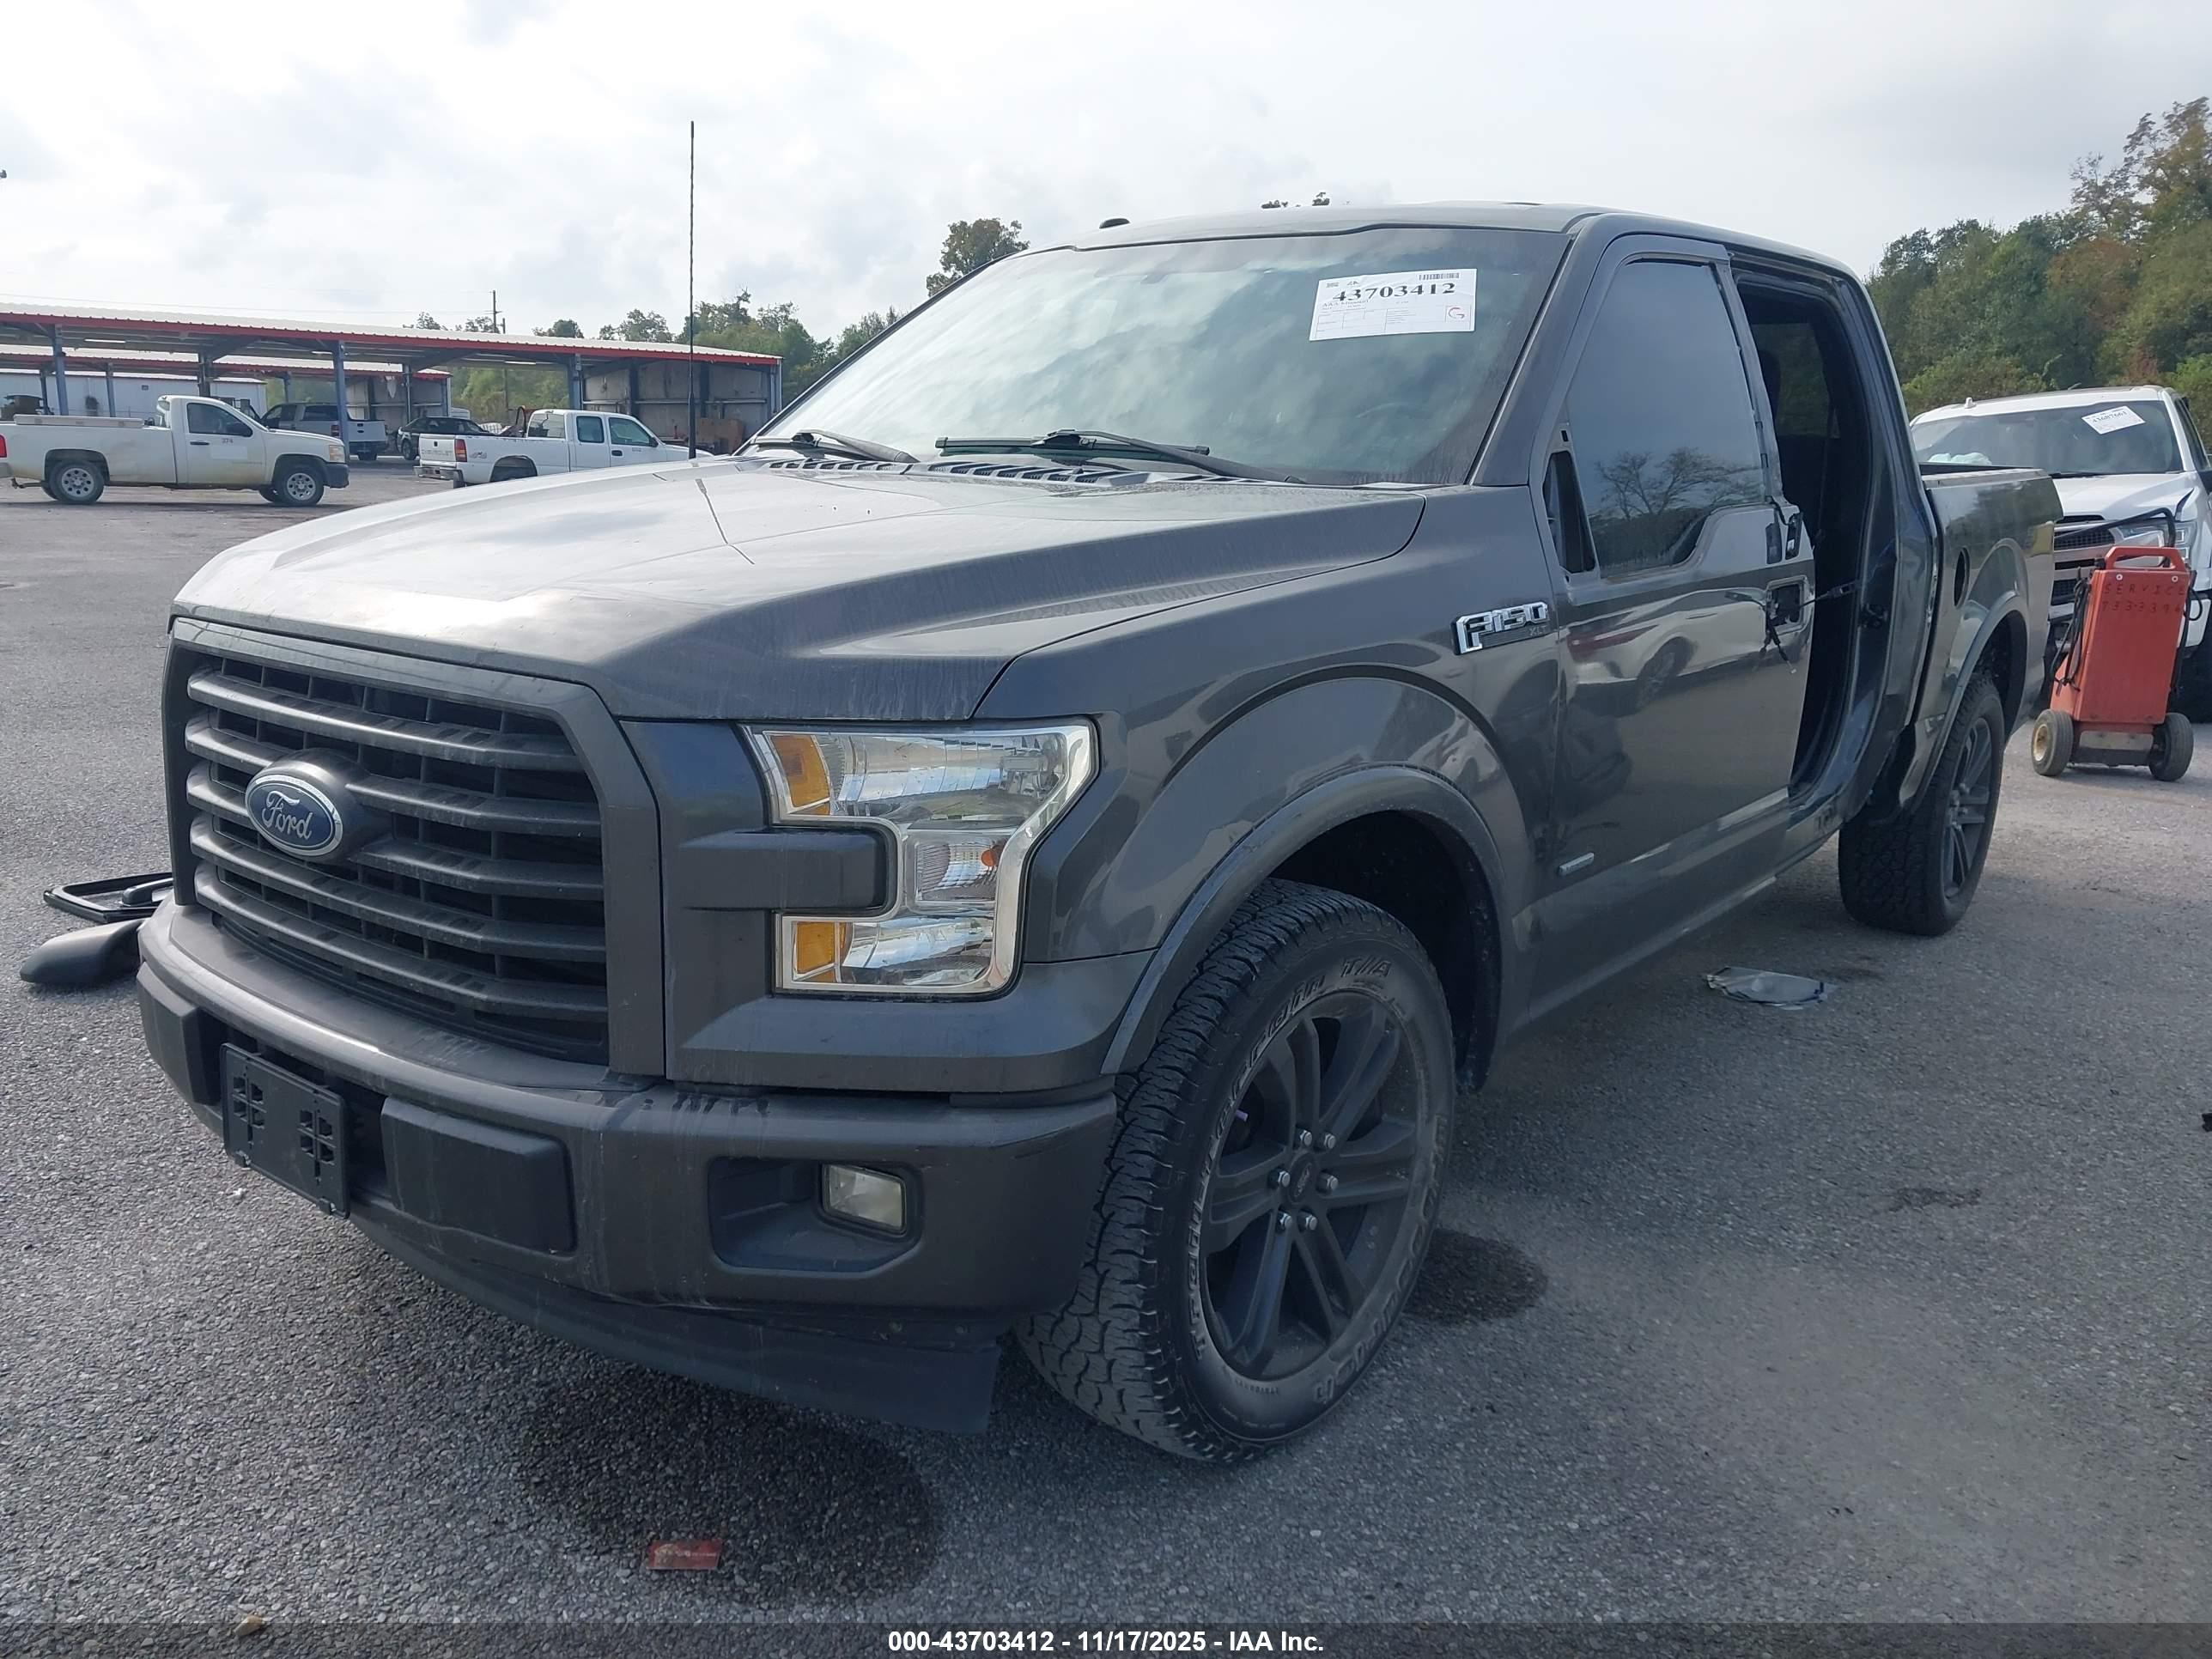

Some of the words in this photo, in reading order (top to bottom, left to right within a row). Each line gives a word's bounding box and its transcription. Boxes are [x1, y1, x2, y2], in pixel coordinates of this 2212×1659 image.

[1333, 283, 1456, 301] 43703412
[2102, 582, 2185, 596] SERVICE
[261, 790, 313, 840] Ford
